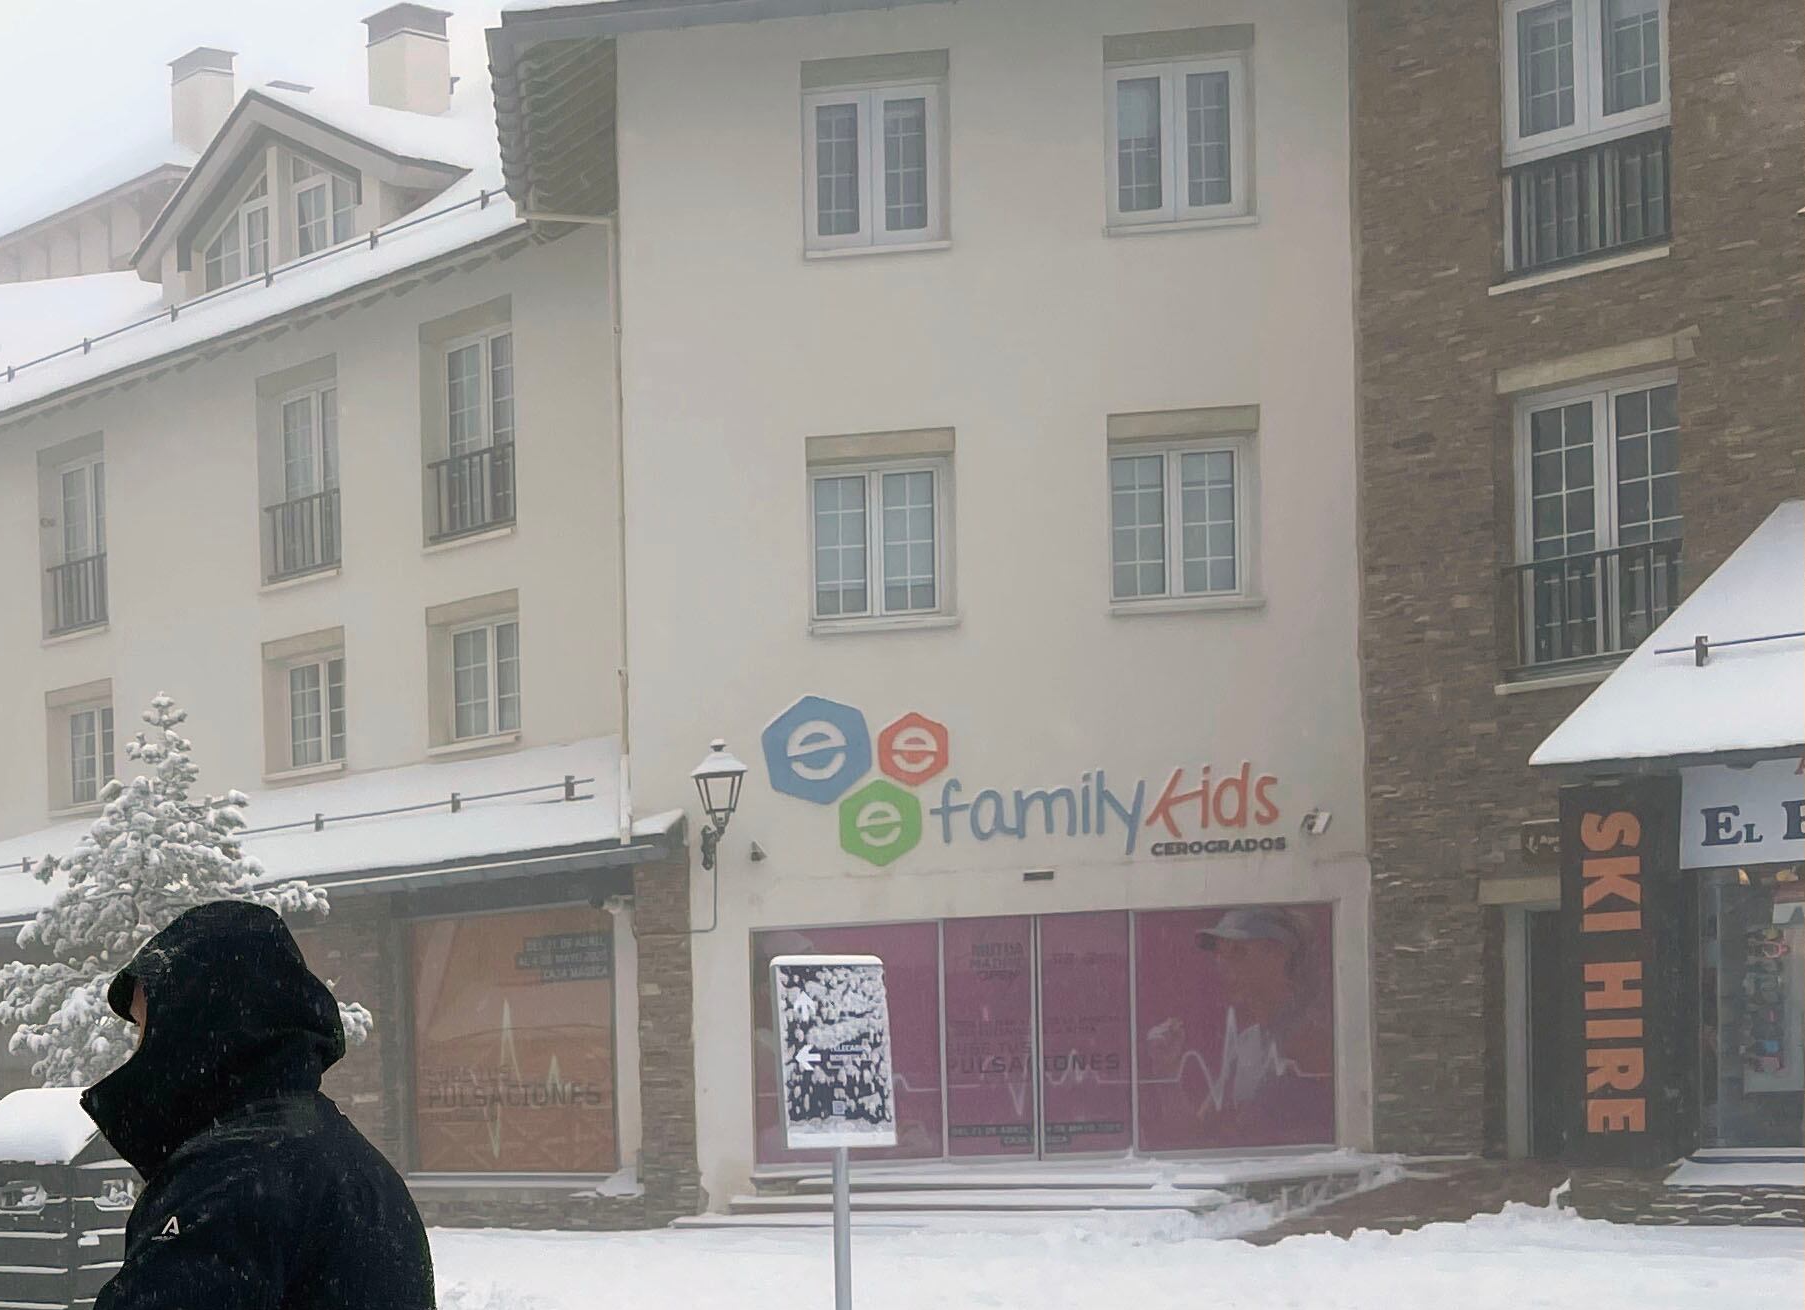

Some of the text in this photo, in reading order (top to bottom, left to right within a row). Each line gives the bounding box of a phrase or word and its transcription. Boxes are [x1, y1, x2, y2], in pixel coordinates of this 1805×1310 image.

[1151, 836, 1286, 858] CEROGRADOS
[1580, 811, 1646, 1133] SKI HIRE
